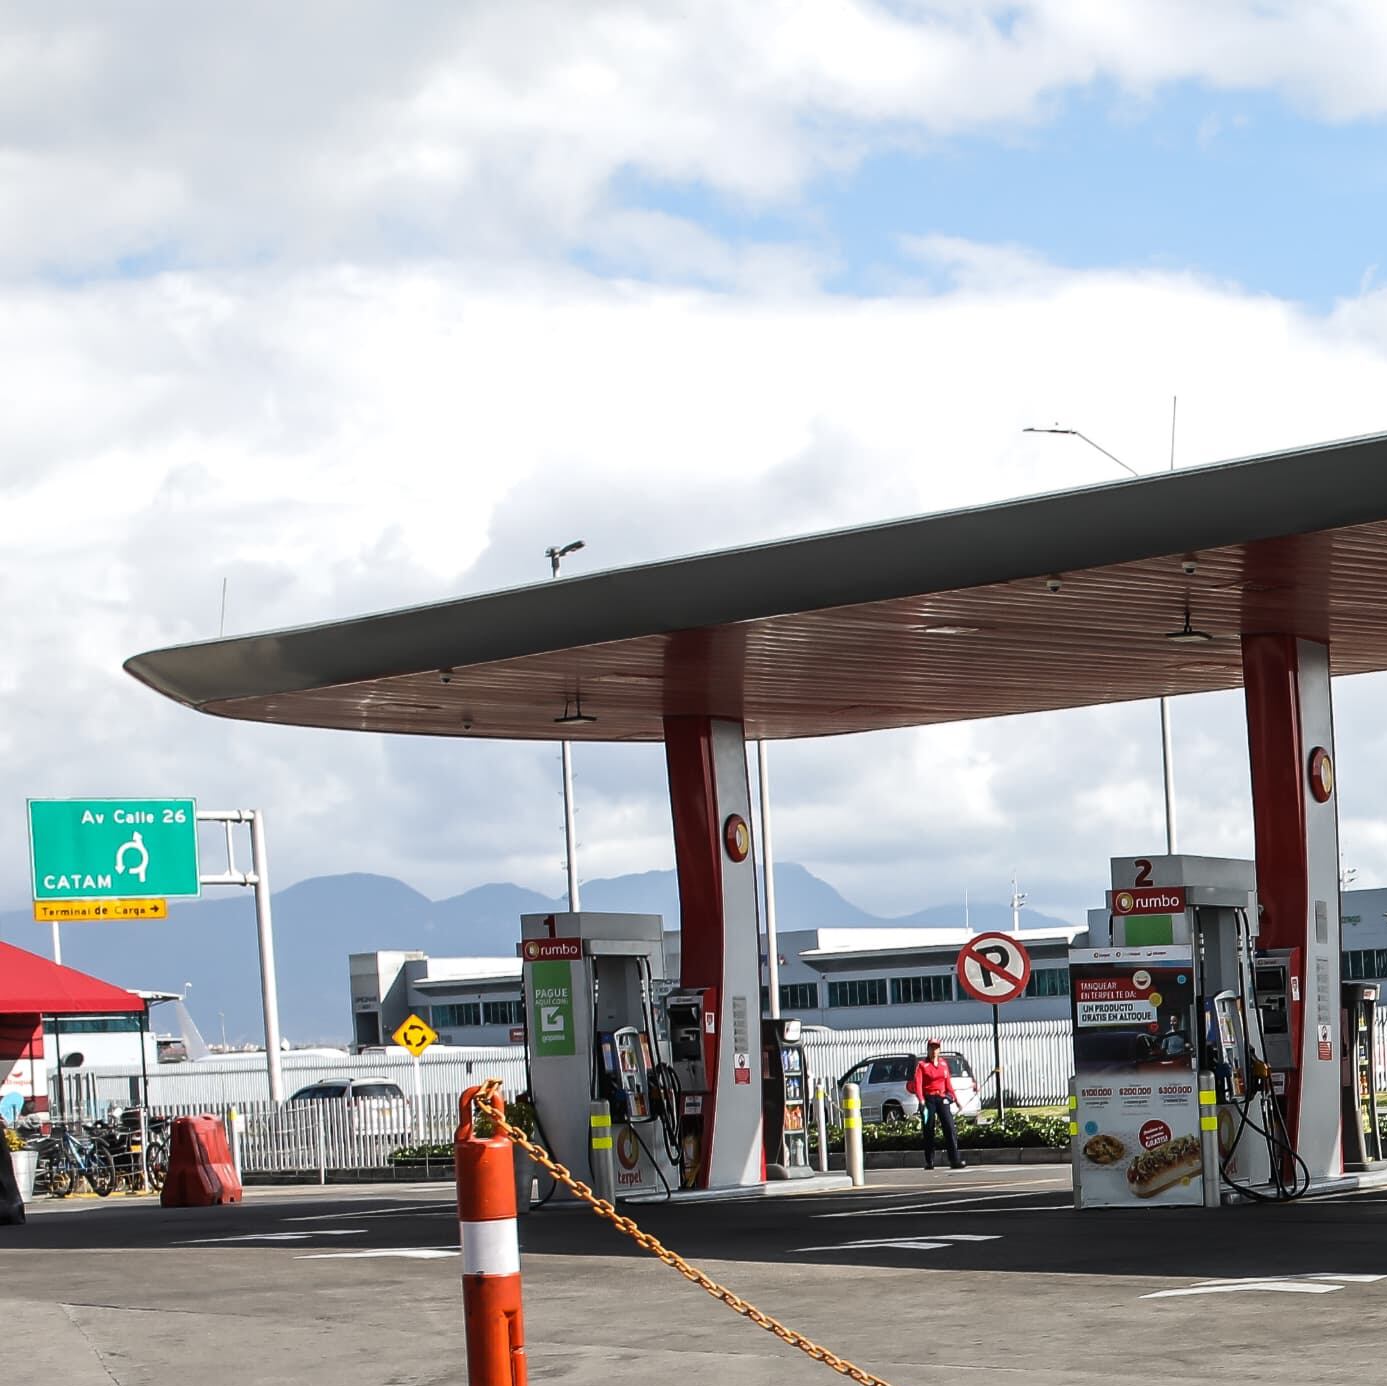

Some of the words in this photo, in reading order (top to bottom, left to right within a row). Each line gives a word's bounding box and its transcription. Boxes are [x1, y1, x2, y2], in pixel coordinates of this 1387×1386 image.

[81, 809, 104, 824] Av
[113, 809, 154, 824] Calle
[163, 809, 186, 824] 26
[1134, 859, 1154, 887] 2
[43, 874, 112, 890] CATAM
[1136, 894, 1180, 908] rumbo
[42, 907, 91, 916] Terminal
[94, 906, 108, 915] de
[543, 914, 556, 938] 1
[541, 943, 578, 956] rumbo
[1080, 982, 1117, 991] TANQUEAR
[535, 988, 568, 999] PAGUE
[1080, 992, 1090, 1000] EN
[1091, 991, 1114, 999] TERPEL
[1116, 990, 1124, 999] TE
[1095, 1003, 1134, 1012] PRODUCTO
[1108, 1013, 1118, 1021] EN
[1120, 1012, 1152, 1021] ALTOQUE
[617, 1169, 642, 1188] terpel
